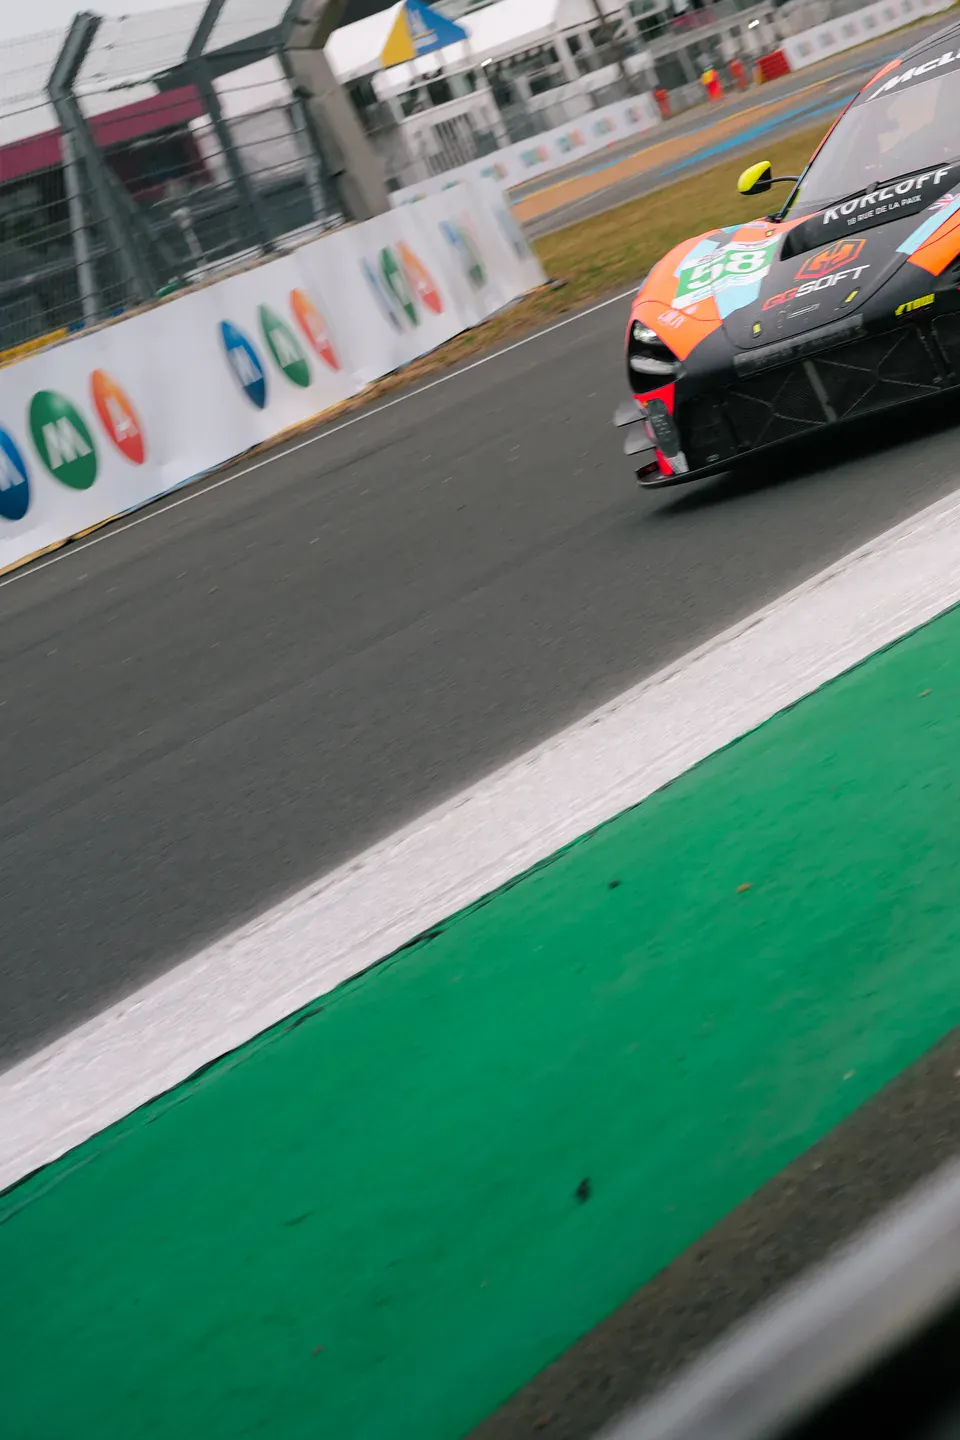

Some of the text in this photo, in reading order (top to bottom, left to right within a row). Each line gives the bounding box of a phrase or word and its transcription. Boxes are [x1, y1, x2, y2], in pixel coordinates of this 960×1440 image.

[822, 166, 952, 225] KORLOFF
[857, 210, 875, 223] RUE
[875, 205, 888, 216] DE
[888, 200, 901, 212] LA
[901, 194, 922, 208] PAIX
[686, 248, 767, 290] 58
[762, 264, 871, 312] GGSOFT
